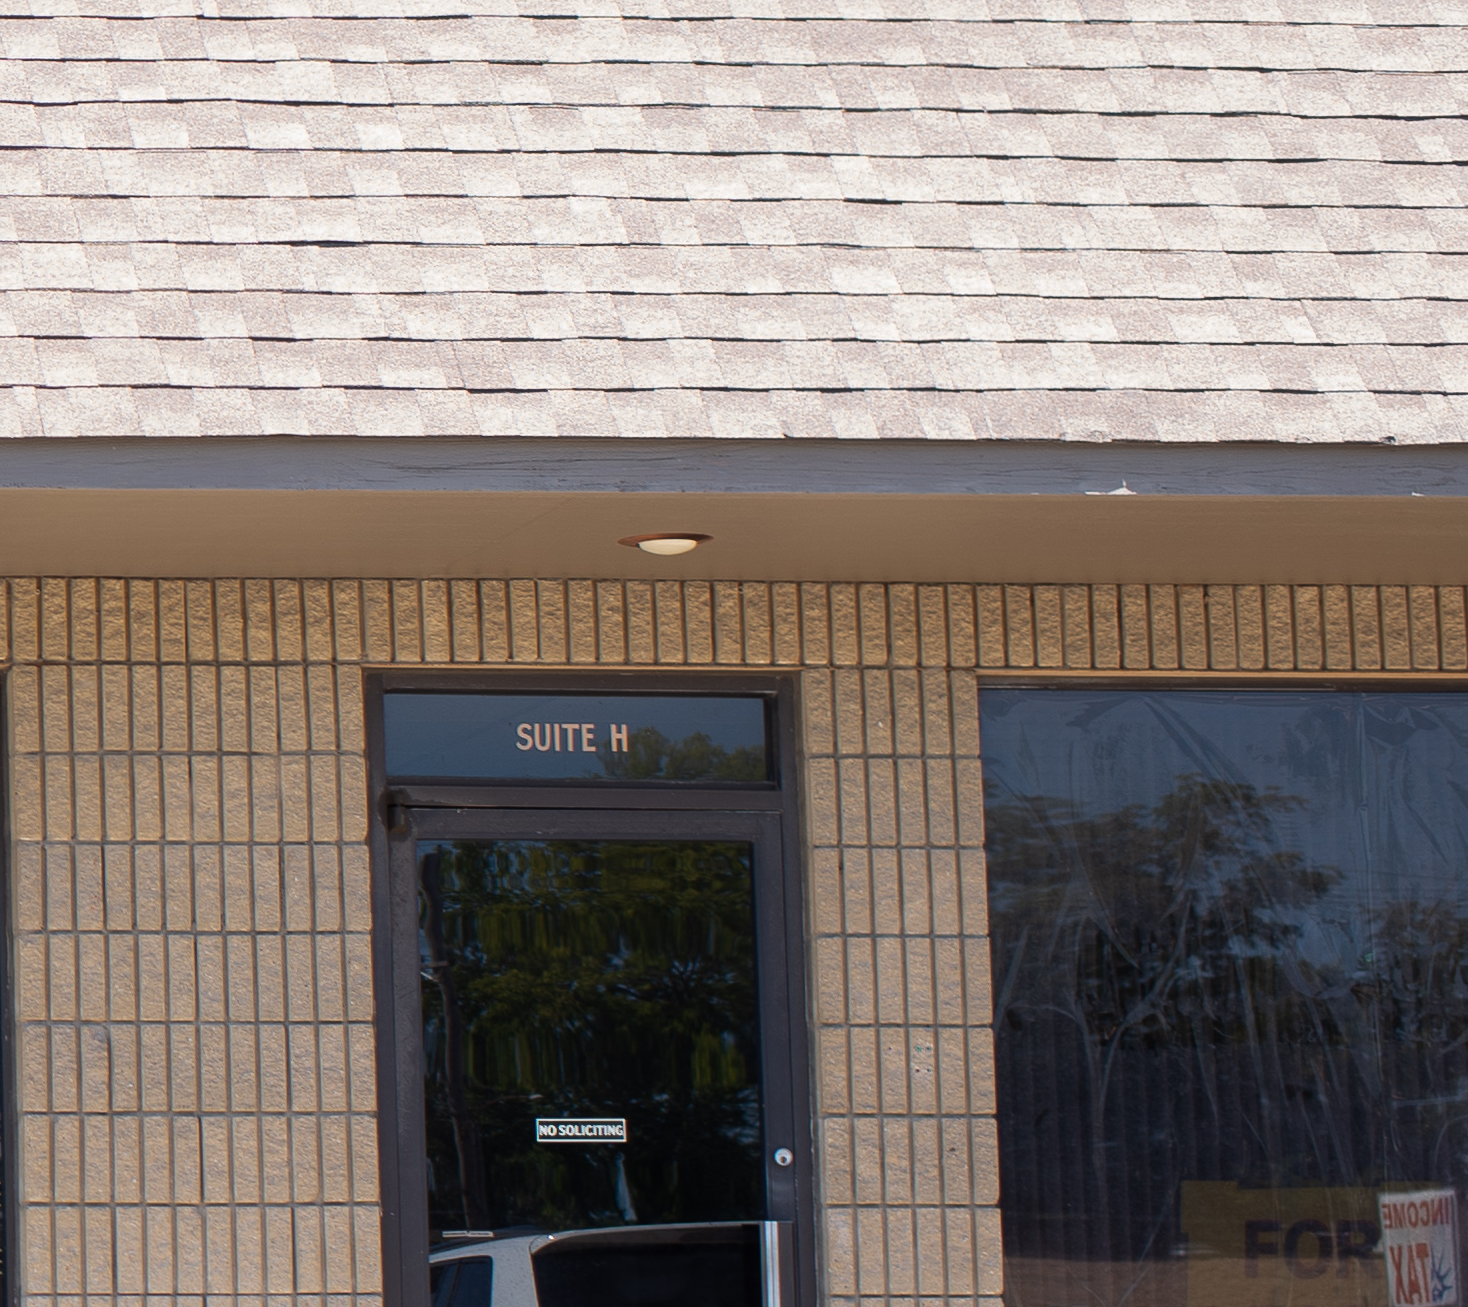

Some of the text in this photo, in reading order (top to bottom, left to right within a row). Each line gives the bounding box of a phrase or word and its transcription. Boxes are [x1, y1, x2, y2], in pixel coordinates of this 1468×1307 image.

[515, 723, 629, 752] SUITE H
[538, 1124, 624, 1136] NO SOLICITING
[1244, 1218, 1382, 1280] FOR
